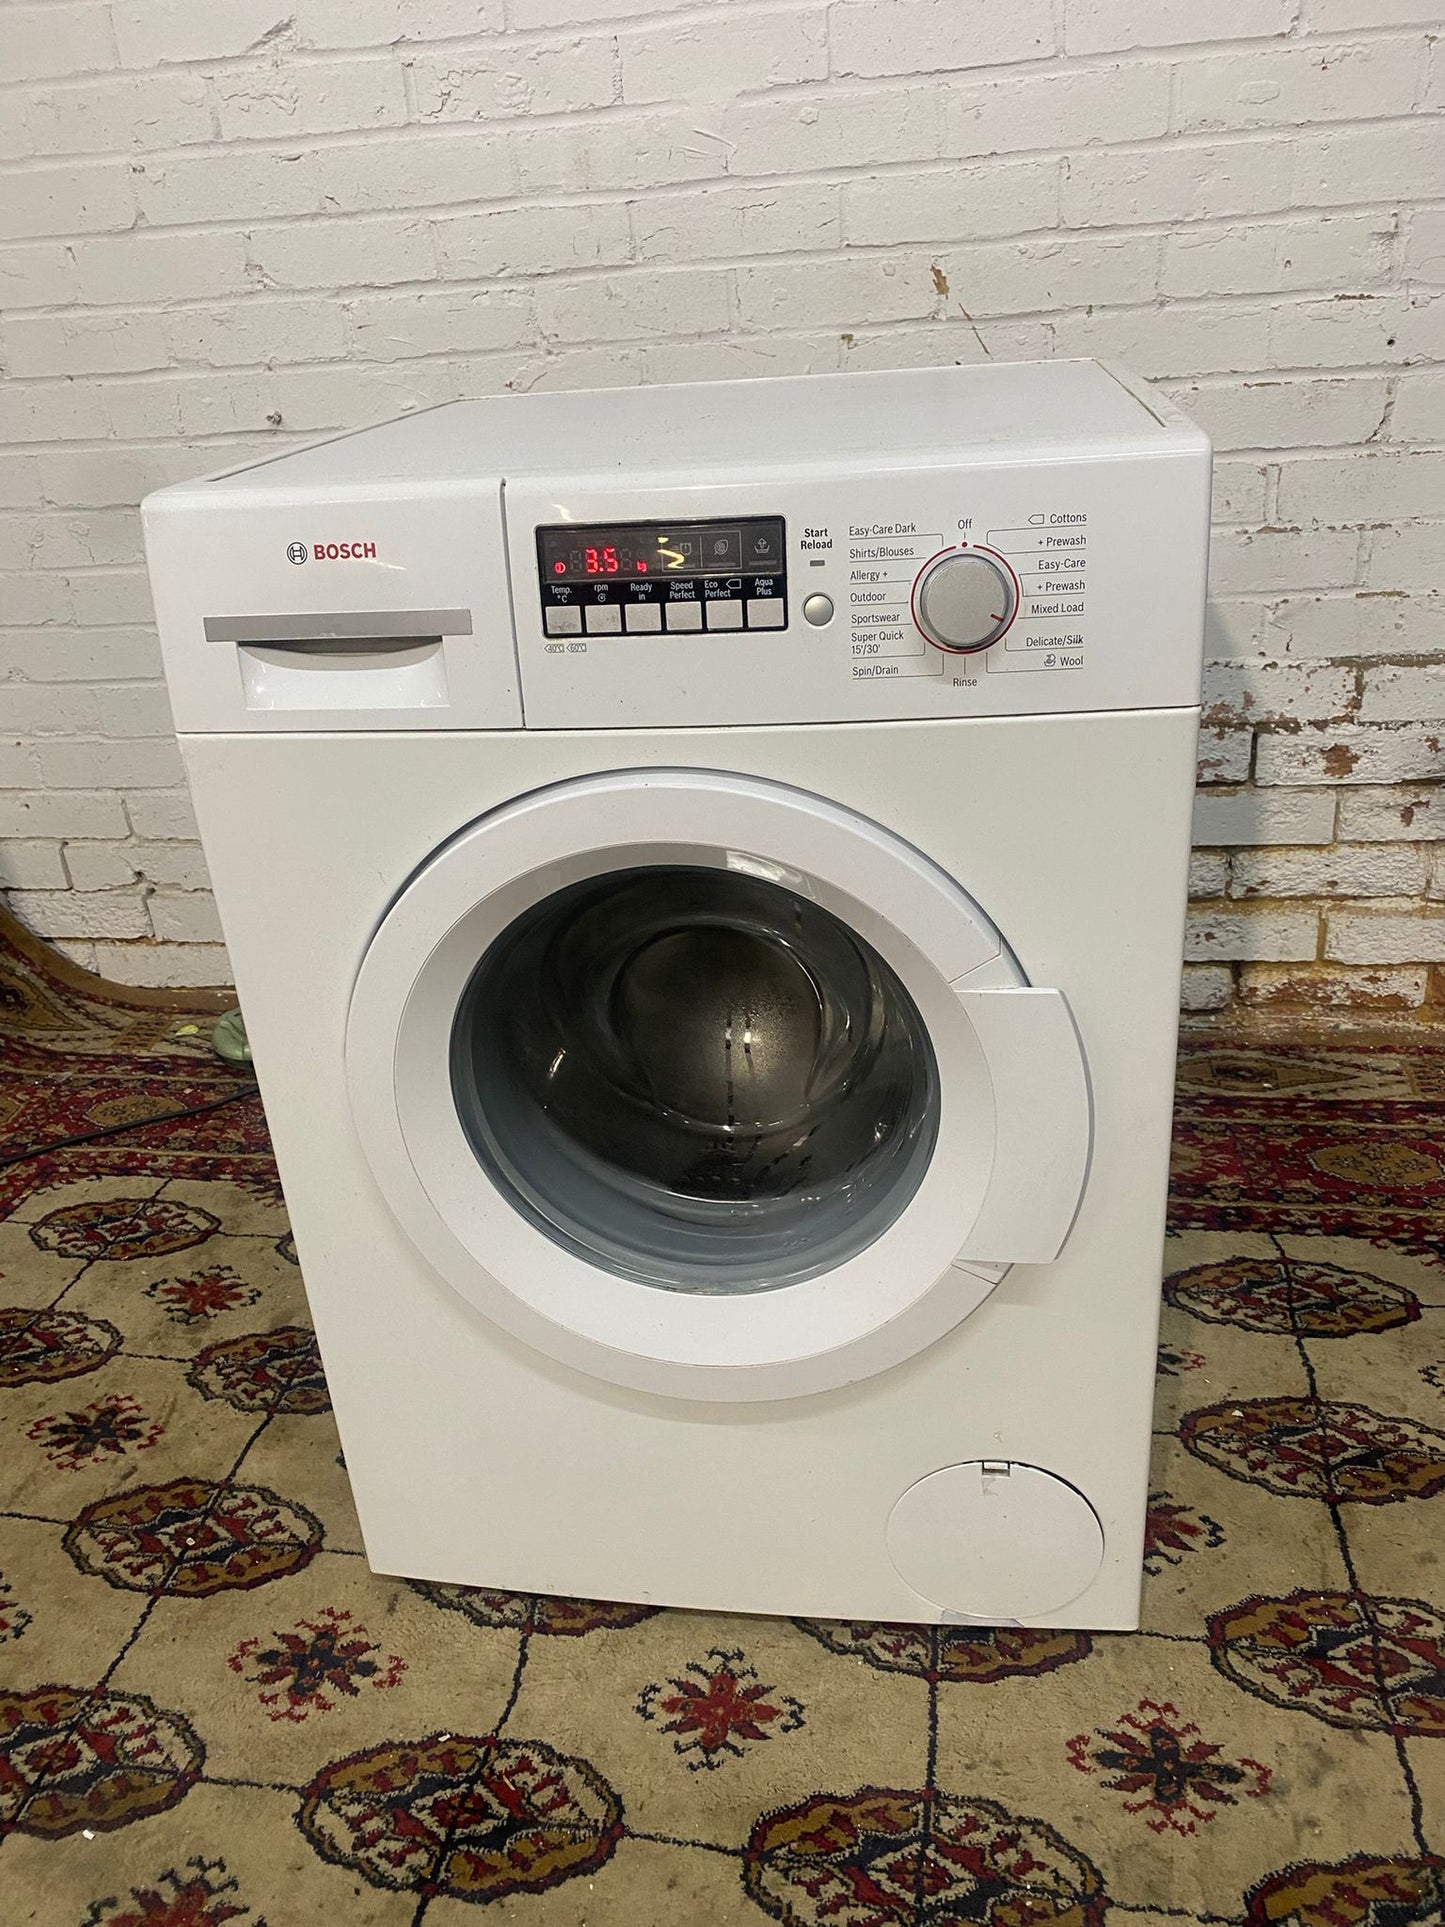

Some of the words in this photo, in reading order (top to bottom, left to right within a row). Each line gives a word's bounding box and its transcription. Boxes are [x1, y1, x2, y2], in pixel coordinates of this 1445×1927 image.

[1050, 513, 1087, 523] Cottons
[849, 525, 893, 536] Easy-Care
[895, 523, 916, 533] Dark
[958, 519, 972, 530] Off
[805, 528, 828, 537] Start
[801, 539, 832, 549] Reload
[1046, 536, 1086, 546] Prewash
[313, 542, 376, 560] BOSCH
[850, 547, 914, 558] Shirts/Blouses
[585, 546, 618, 573] 3.5
[1039, 559, 1085, 570] Easy-Care
[850, 570, 880, 581] Allergy
[630, 583, 652, 593] Ready
[671, 581, 693, 590] Speed
[755, 579, 773, 588] Aqua
[1046, 581, 1085, 591] Prewash
[551, 585, 572, 595] Temp.
[670, 590, 695, 599] Perfect
[705, 589, 730, 598] Perfect
[757, 587, 772, 595] Plus
[639, 593, 645, 601] in
[851, 592, 886, 602] Outdoor
[1031, 604, 1058, 614] Mixed
[1061, 603, 1084, 612] Load
[852, 613, 900, 624] Sportswear
[852, 632, 877, 642] Super
[879, 631, 904, 641] Quick
[1026, 636, 1083, 647] Delicate/Silk
[1060, 656, 1083, 666] Wool
[853, 665, 898, 676] Spin/Drain
[953, 678, 977, 686] Rinse
